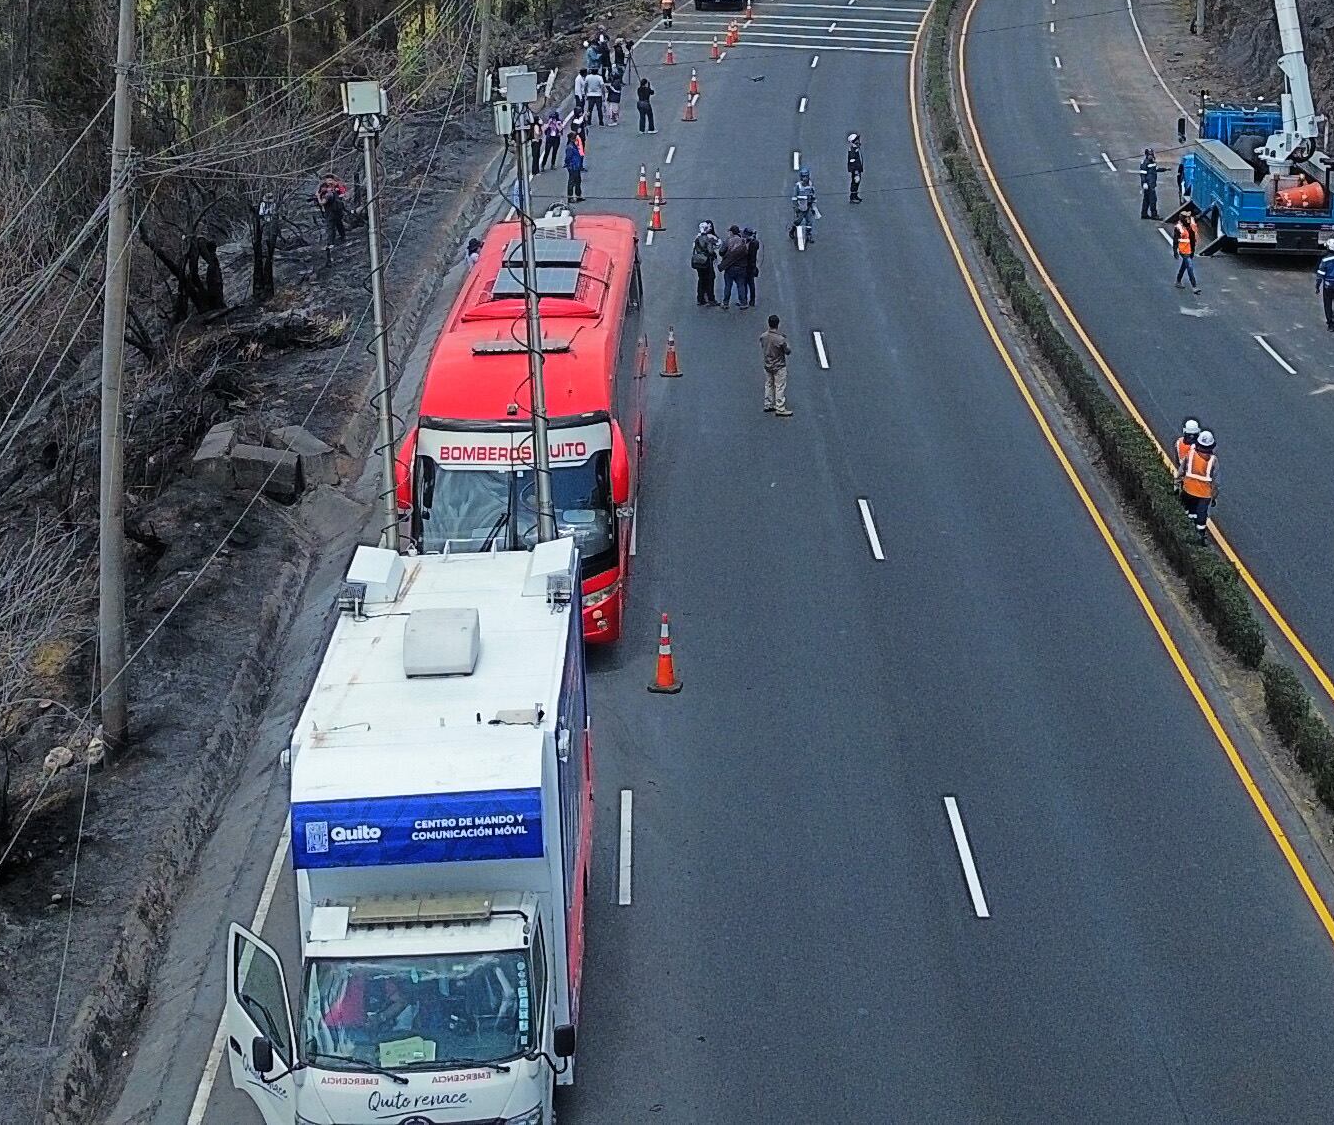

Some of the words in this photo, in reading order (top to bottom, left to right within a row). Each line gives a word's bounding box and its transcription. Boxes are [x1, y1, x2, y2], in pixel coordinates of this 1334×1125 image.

[439, 446, 532, 461] BOMBEROS
[550, 442, 586, 458] UITO
[414, 818, 456, 829] CENTRO
[458, 817, 473, 826] DE
[475, 815, 515, 825] MANDO
[516, 814, 524, 823] Y
[330, 825, 382, 841] Quito
[411, 826, 493, 841] COMUNICACIÓN
[494, 825, 528, 836] MÓVIL
[368, 1090, 411, 1111] Quito
[414, 1092, 473, 1108] renace.
